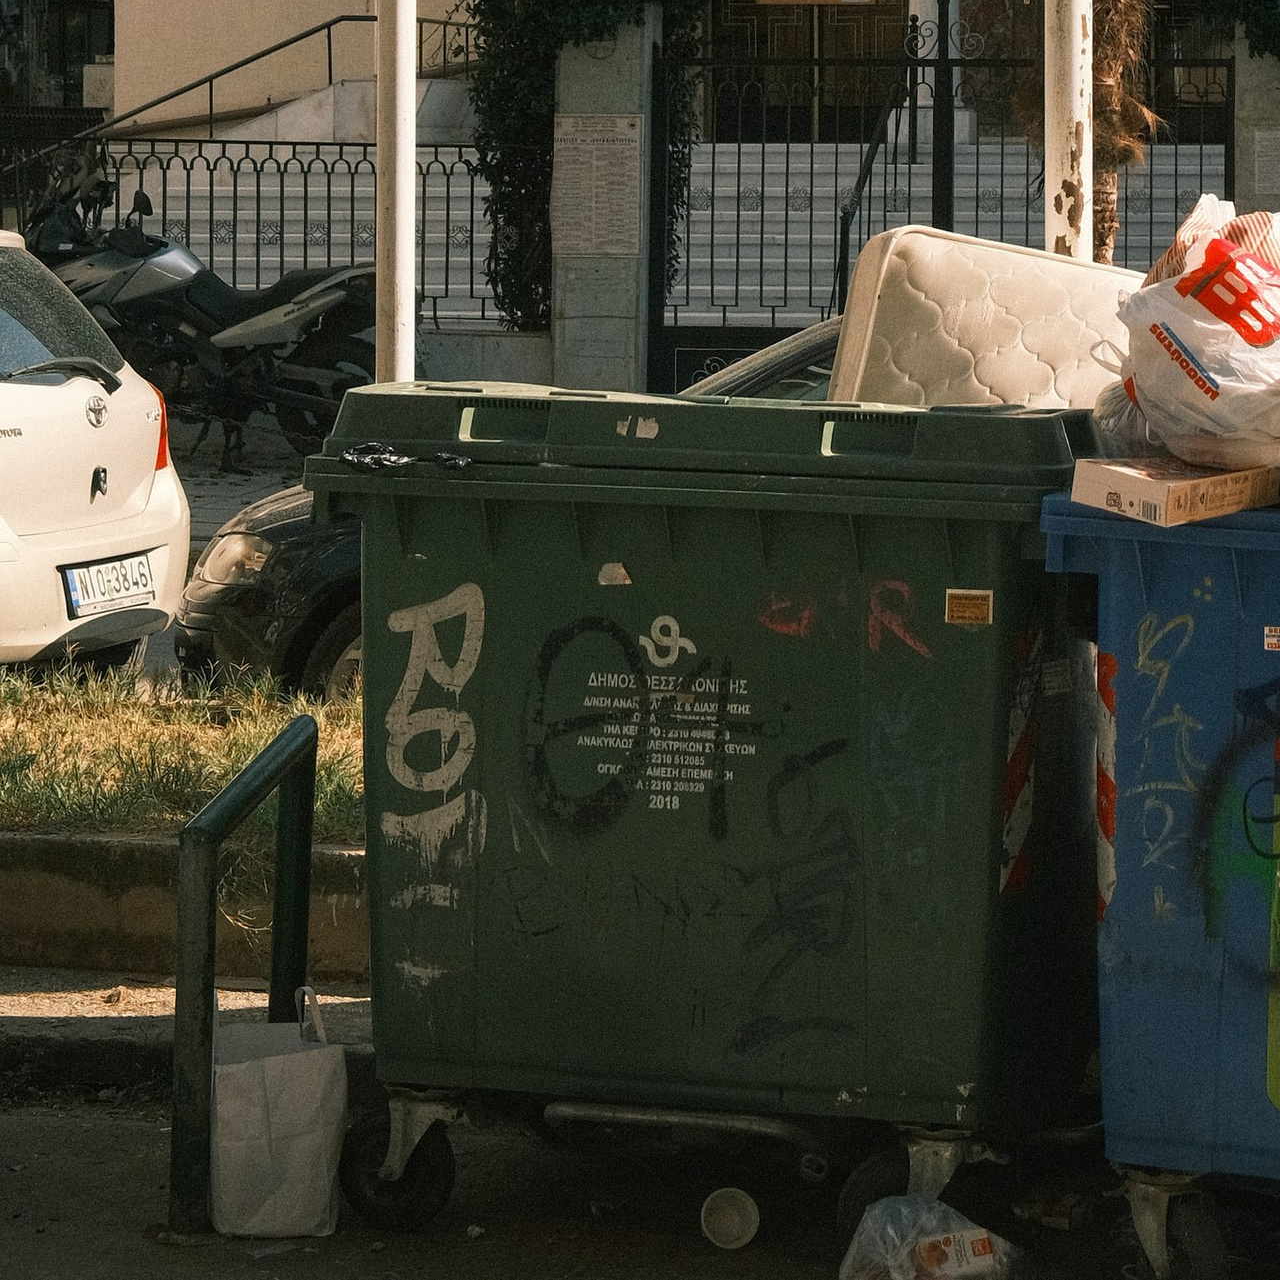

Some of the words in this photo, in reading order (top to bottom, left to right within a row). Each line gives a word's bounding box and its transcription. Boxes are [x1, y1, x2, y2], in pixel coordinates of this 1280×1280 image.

[588, 673, 637, 688] ΔΗΜΟΣ
[577, 736, 638, 749] ΑΝΑΚΥΚΛΩΣ
[648, 795, 680, 810] 2018
